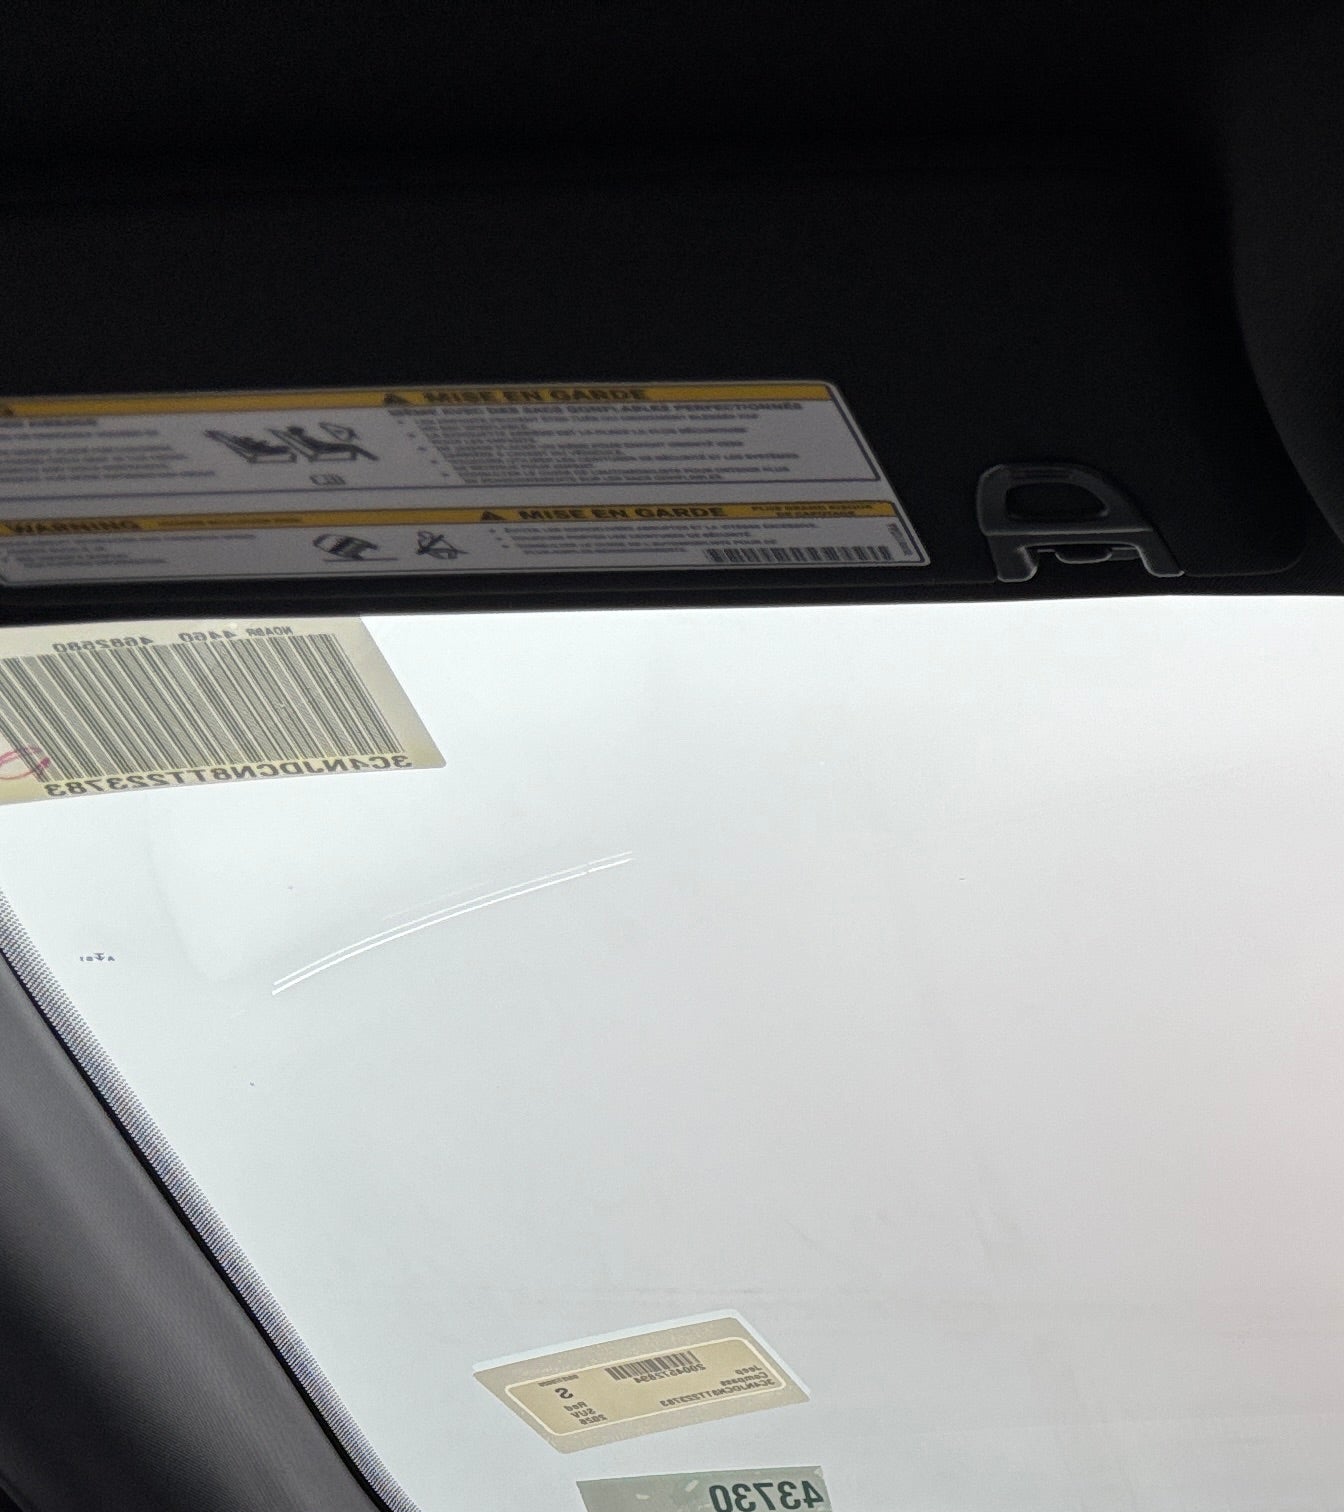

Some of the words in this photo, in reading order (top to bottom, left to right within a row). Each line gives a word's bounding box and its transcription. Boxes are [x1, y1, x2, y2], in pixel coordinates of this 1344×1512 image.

[425, 390, 482, 403] MISE
[501, 390, 542, 402] EN
[550, 389, 647, 402] GARDE
[518, 509, 584, 521] MISE
[592, 509, 629, 519] EN
[635, 507, 725, 518] GARDE
